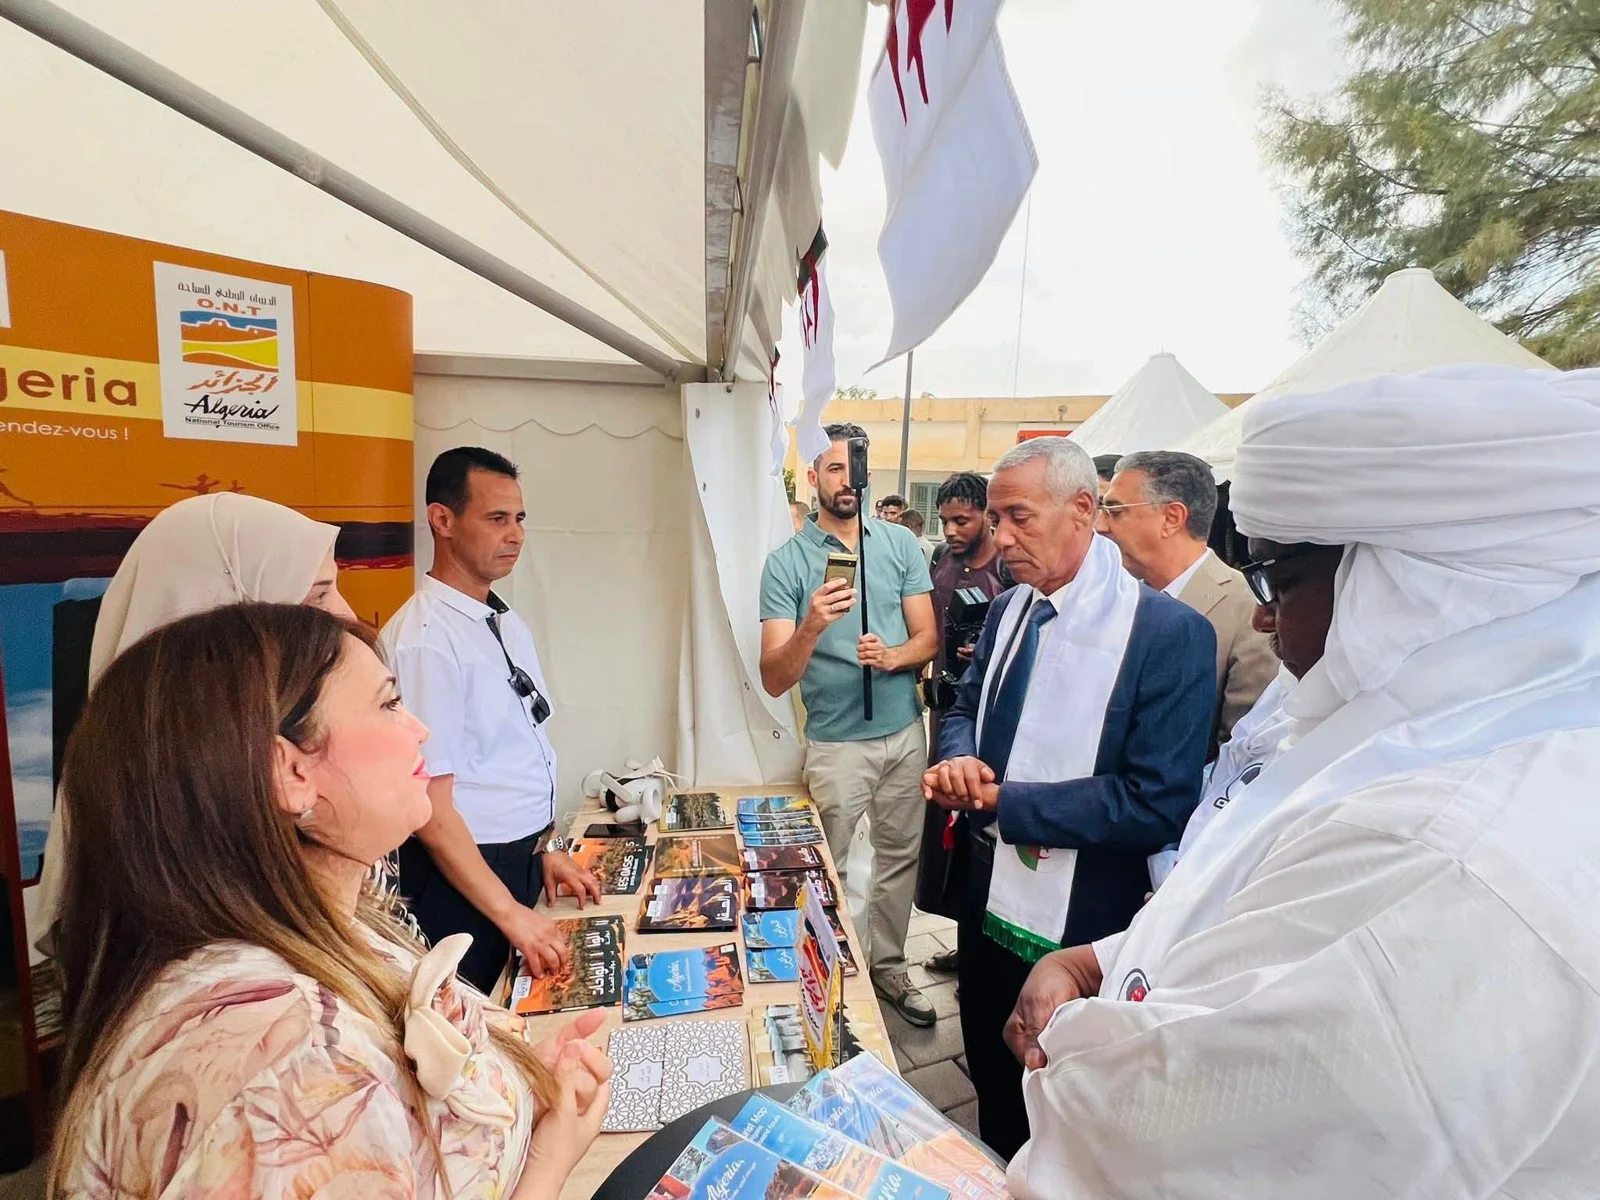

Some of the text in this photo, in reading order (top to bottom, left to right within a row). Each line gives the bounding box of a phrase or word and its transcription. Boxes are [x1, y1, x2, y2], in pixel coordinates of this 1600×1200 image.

[196, 298, 262, 317] O.N.T
[0, 366, 138, 407] eria
[186, 369, 279, 396] الجزائر
[184, 394, 280, 422] Algeria
[185, 416, 280, 431] National Tourism Office
[620, 854, 635, 877] OASIS
[617, 876, 630, 890] LES
[750, 1106, 768, 1124] Map
